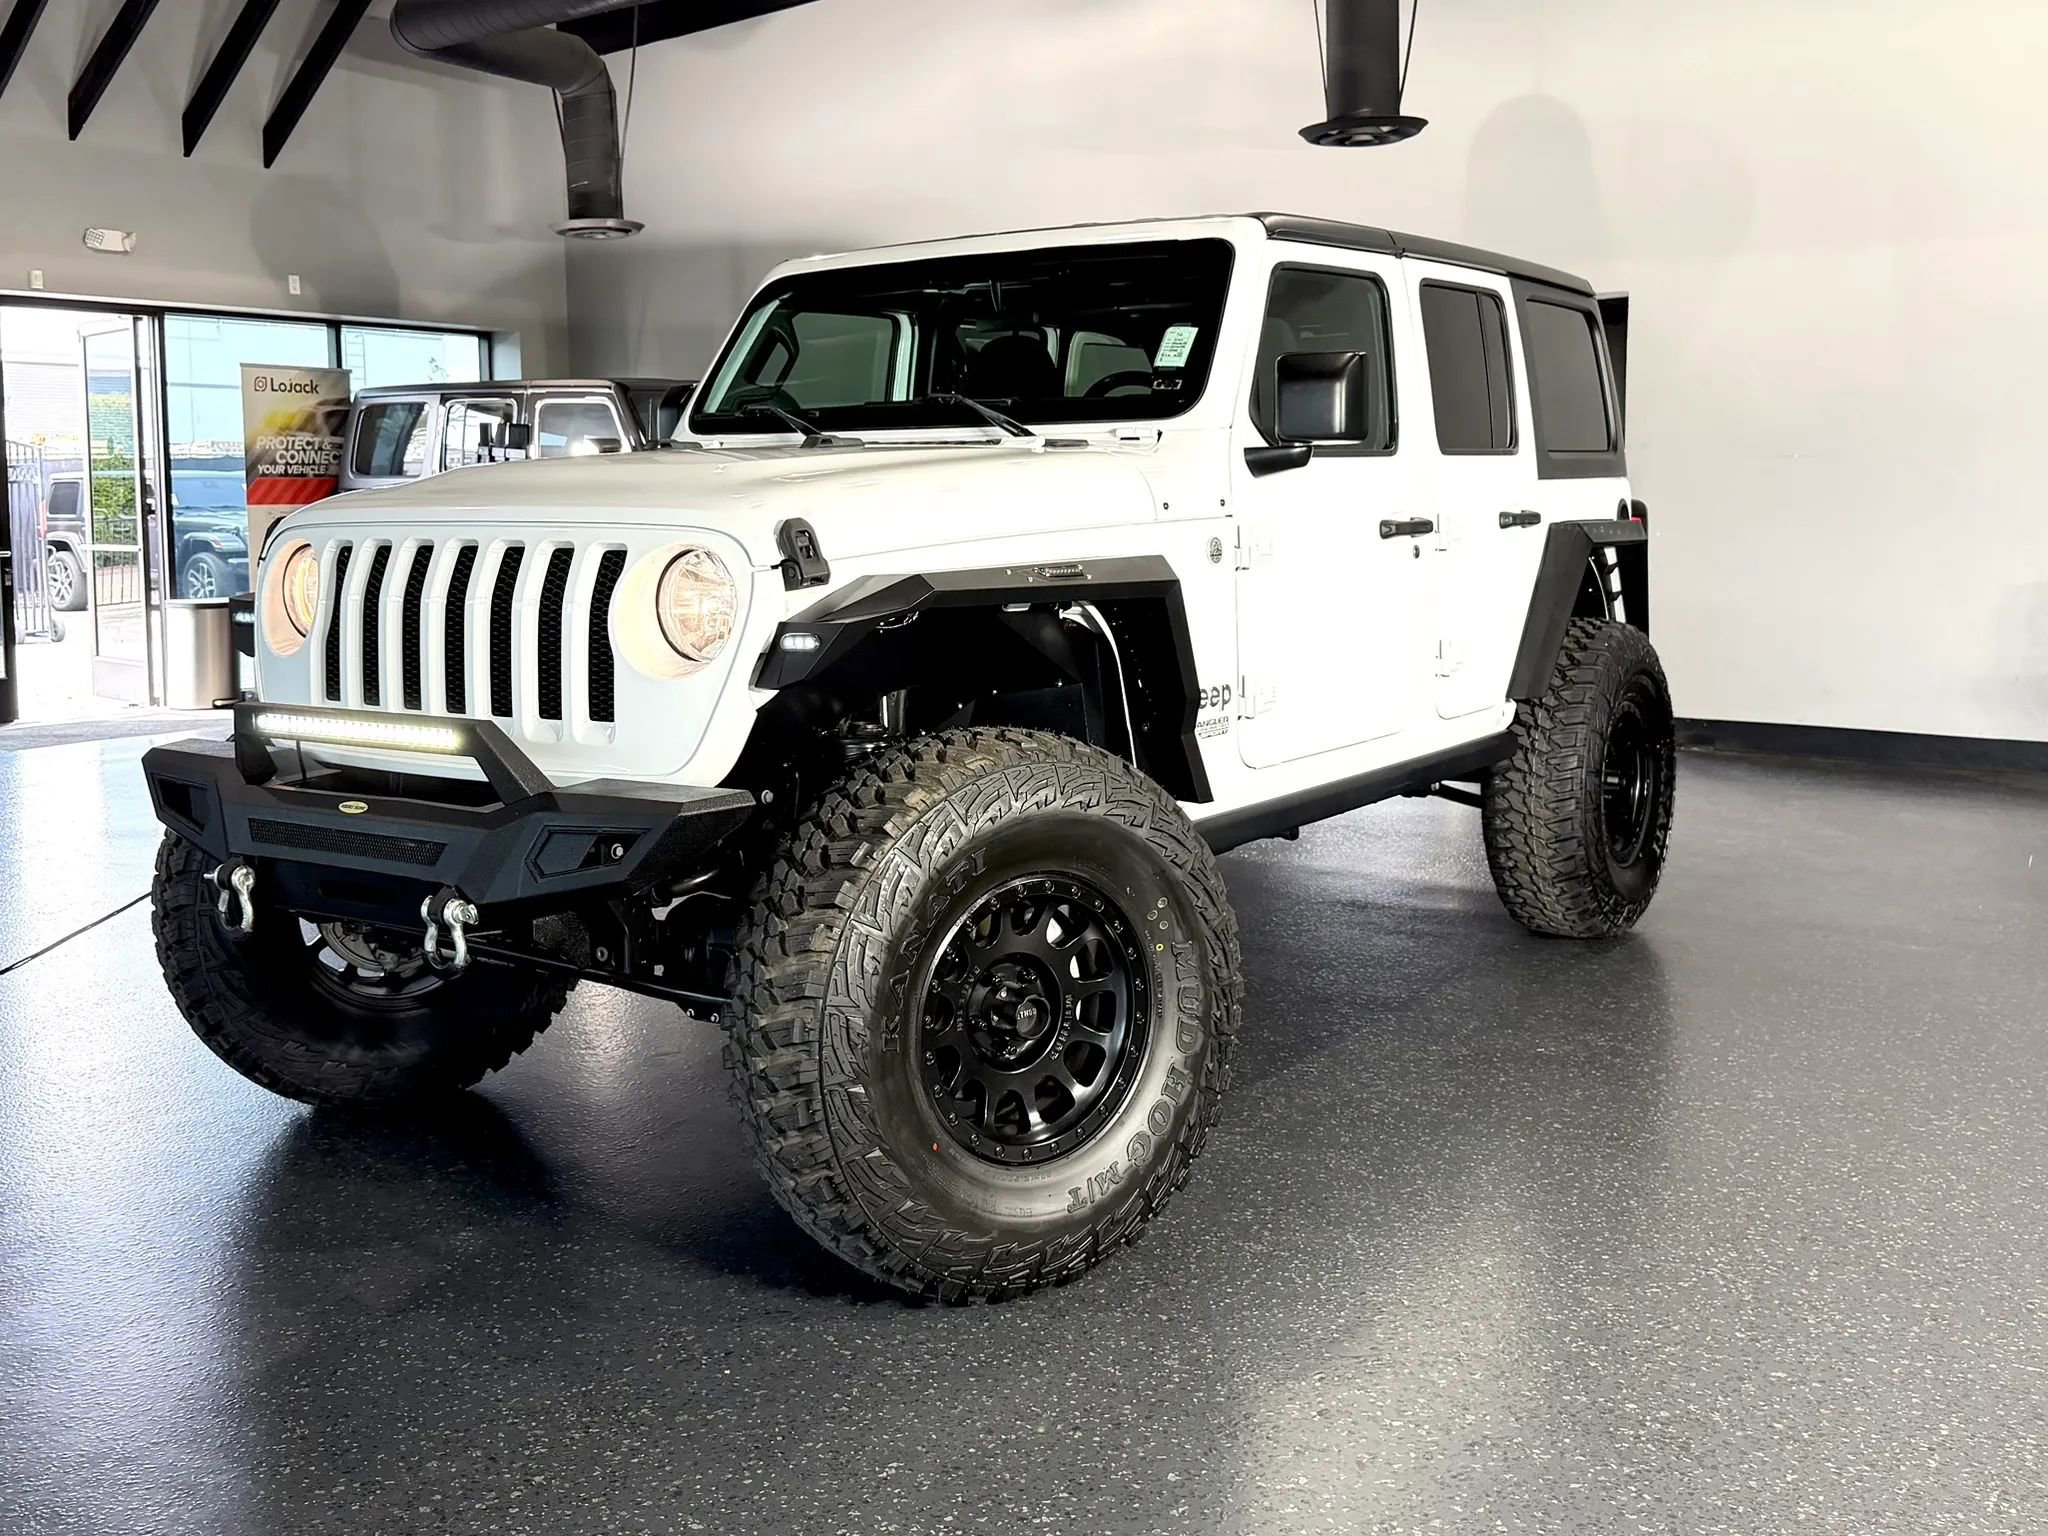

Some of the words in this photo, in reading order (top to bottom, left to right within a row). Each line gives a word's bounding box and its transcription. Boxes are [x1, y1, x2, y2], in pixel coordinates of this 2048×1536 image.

[256, 436, 321, 450] PROTECT
[322, 439, 333, 450] &
[276, 450, 342, 465] CONNEC
[258, 464, 285, 474] YOUR
[287, 465, 326, 475] VEHICLE
[1198, 684, 1231, 711] eep
[882, 848, 988, 1053] KANATI
[1171, 941, 1201, 1055] MUD
[1126, 1062, 1190, 1167] HOG
[1067, 1161, 1121, 1214] M/T
